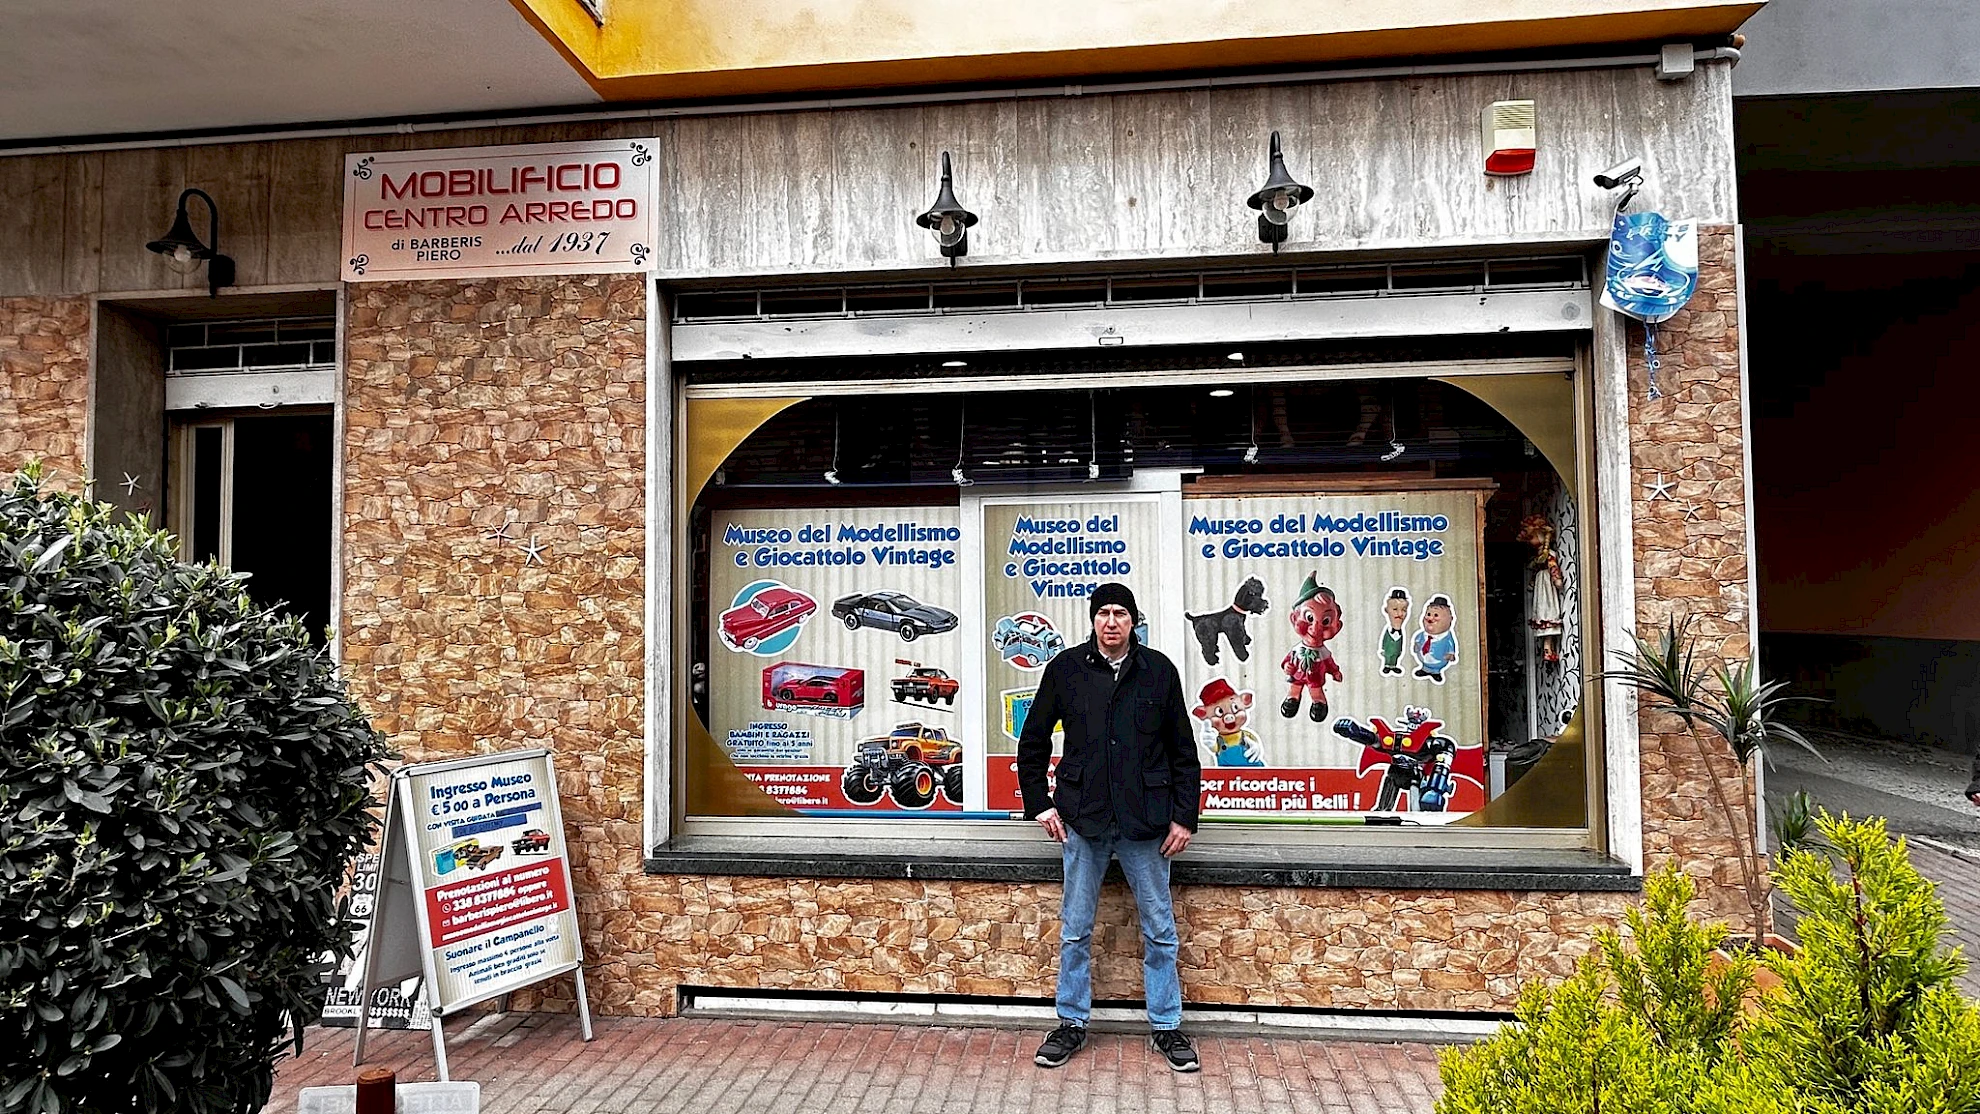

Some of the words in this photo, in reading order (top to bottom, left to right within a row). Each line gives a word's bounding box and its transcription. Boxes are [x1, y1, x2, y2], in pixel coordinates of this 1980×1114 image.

[381, 162, 620, 200] MOBILIFICIO
[364, 204, 488, 230] CENTRO
[499, 198, 637, 224] ARREDO
[391, 239, 405, 250] di
[410, 236, 482, 250] BARBERIS
[549, 231, 611, 255] 1937
[416, 249, 461, 261] PIERO
[1015, 516, 1081, 534] Museo
[1086, 515, 1119, 533] del
[1188, 515, 1263, 535] Museo
[1269, 514, 1306, 533] del
[1312, 512, 1448, 533] Modellismo
[725, 524, 792, 544] Museo
[798, 525, 831, 543] del
[837, 523, 961, 543] Modellismo
[1009, 537, 1126, 556] Modellismo
[1202, 545, 1215, 558] e
[1222, 538, 1345, 558] Giocattolo
[1350, 536, 1443, 560] Vintage
[735, 552, 748, 566] e
[754, 547, 866, 566] Giocattolo
[872, 546, 956, 568] Vintage
[1005, 563, 1017, 577] e
[1023, 558, 1131, 577] Giocattolo
[1031, 579, 1097, 600] Vintag
[730, 731, 763, 739] BAMBINI
[772, 731, 810, 739] RAGAZZI
[430, 781, 487, 799] Ingresso
[491, 774, 532, 788] Museo
[764, 773, 831, 782] PRENOTAZIONE
[1200, 779, 1225, 793] per
[1229, 776, 1305, 792] ricordare
[1309, 776, 1316, 792] i
[472, 798, 481, 808] a
[484, 789, 536, 806] Persona
[1205, 793, 1276, 809] Momenti
[1281, 794, 1307, 810] più
[1311, 793, 1348, 809] Belli
[427, 822, 442, 830] CON
[444, 818, 465, 827] VISITA
[467, 813, 496, 823] GUIDATA
[356, 852, 380, 864] SPE
[357, 863, 378, 872] LIMI
[352, 873, 377, 891] 30
[437, 876, 500, 902] Prenotazioni
[502, 874, 511, 884] al
[514, 867, 550, 882] numero
[517, 880, 547, 894] oppure
[355, 905, 367, 913] 66
[445, 943, 482, 961] Suonare
[485, 939, 491, 949] il
[493, 925, 545, 946] Campanello
[450, 962, 476, 973] Ingresso
[477, 952, 503, 964] massimo
[509, 943, 532, 955] persone
[534, 939, 544, 947] alla
[468, 965, 492, 977] Animali
[500, 964, 522, 976] braccio
